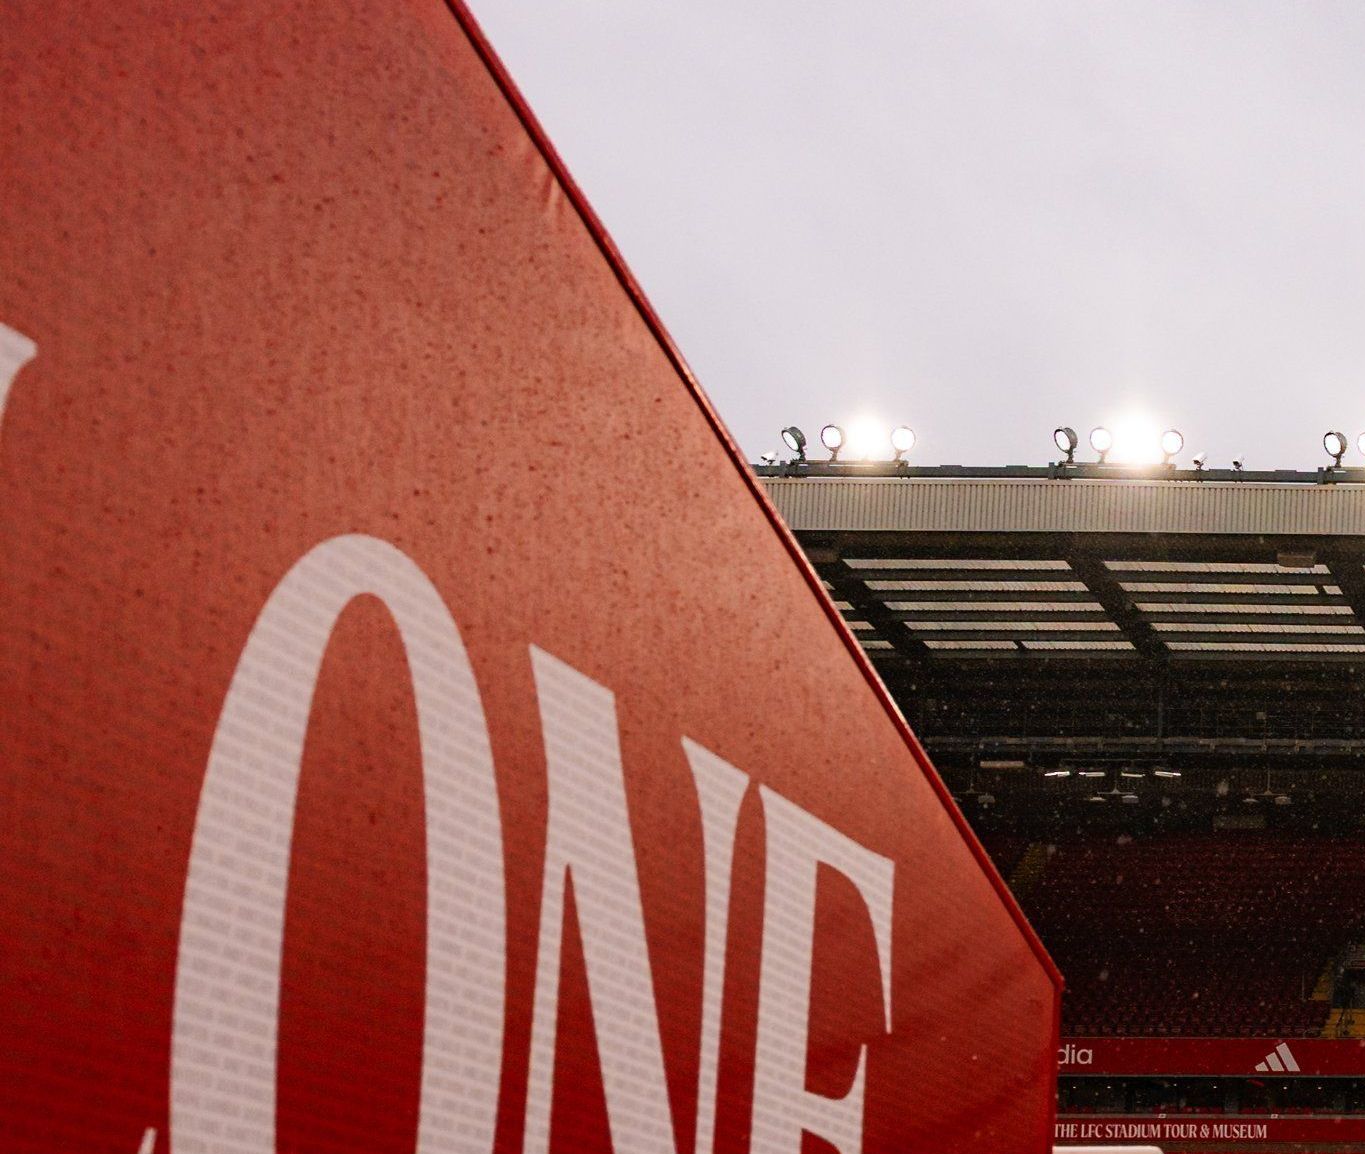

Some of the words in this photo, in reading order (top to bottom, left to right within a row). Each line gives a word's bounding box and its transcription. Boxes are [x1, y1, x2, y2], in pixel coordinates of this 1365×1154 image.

[1080, 1123, 1103, 1139] LFC
[1105, 1123, 1161, 1139] STADIUM
[1163, 1123, 1198, 1139] TOUR
[1199, 1123, 1210, 1139] &
[1212, 1124, 1267, 1139] MUSEUM
